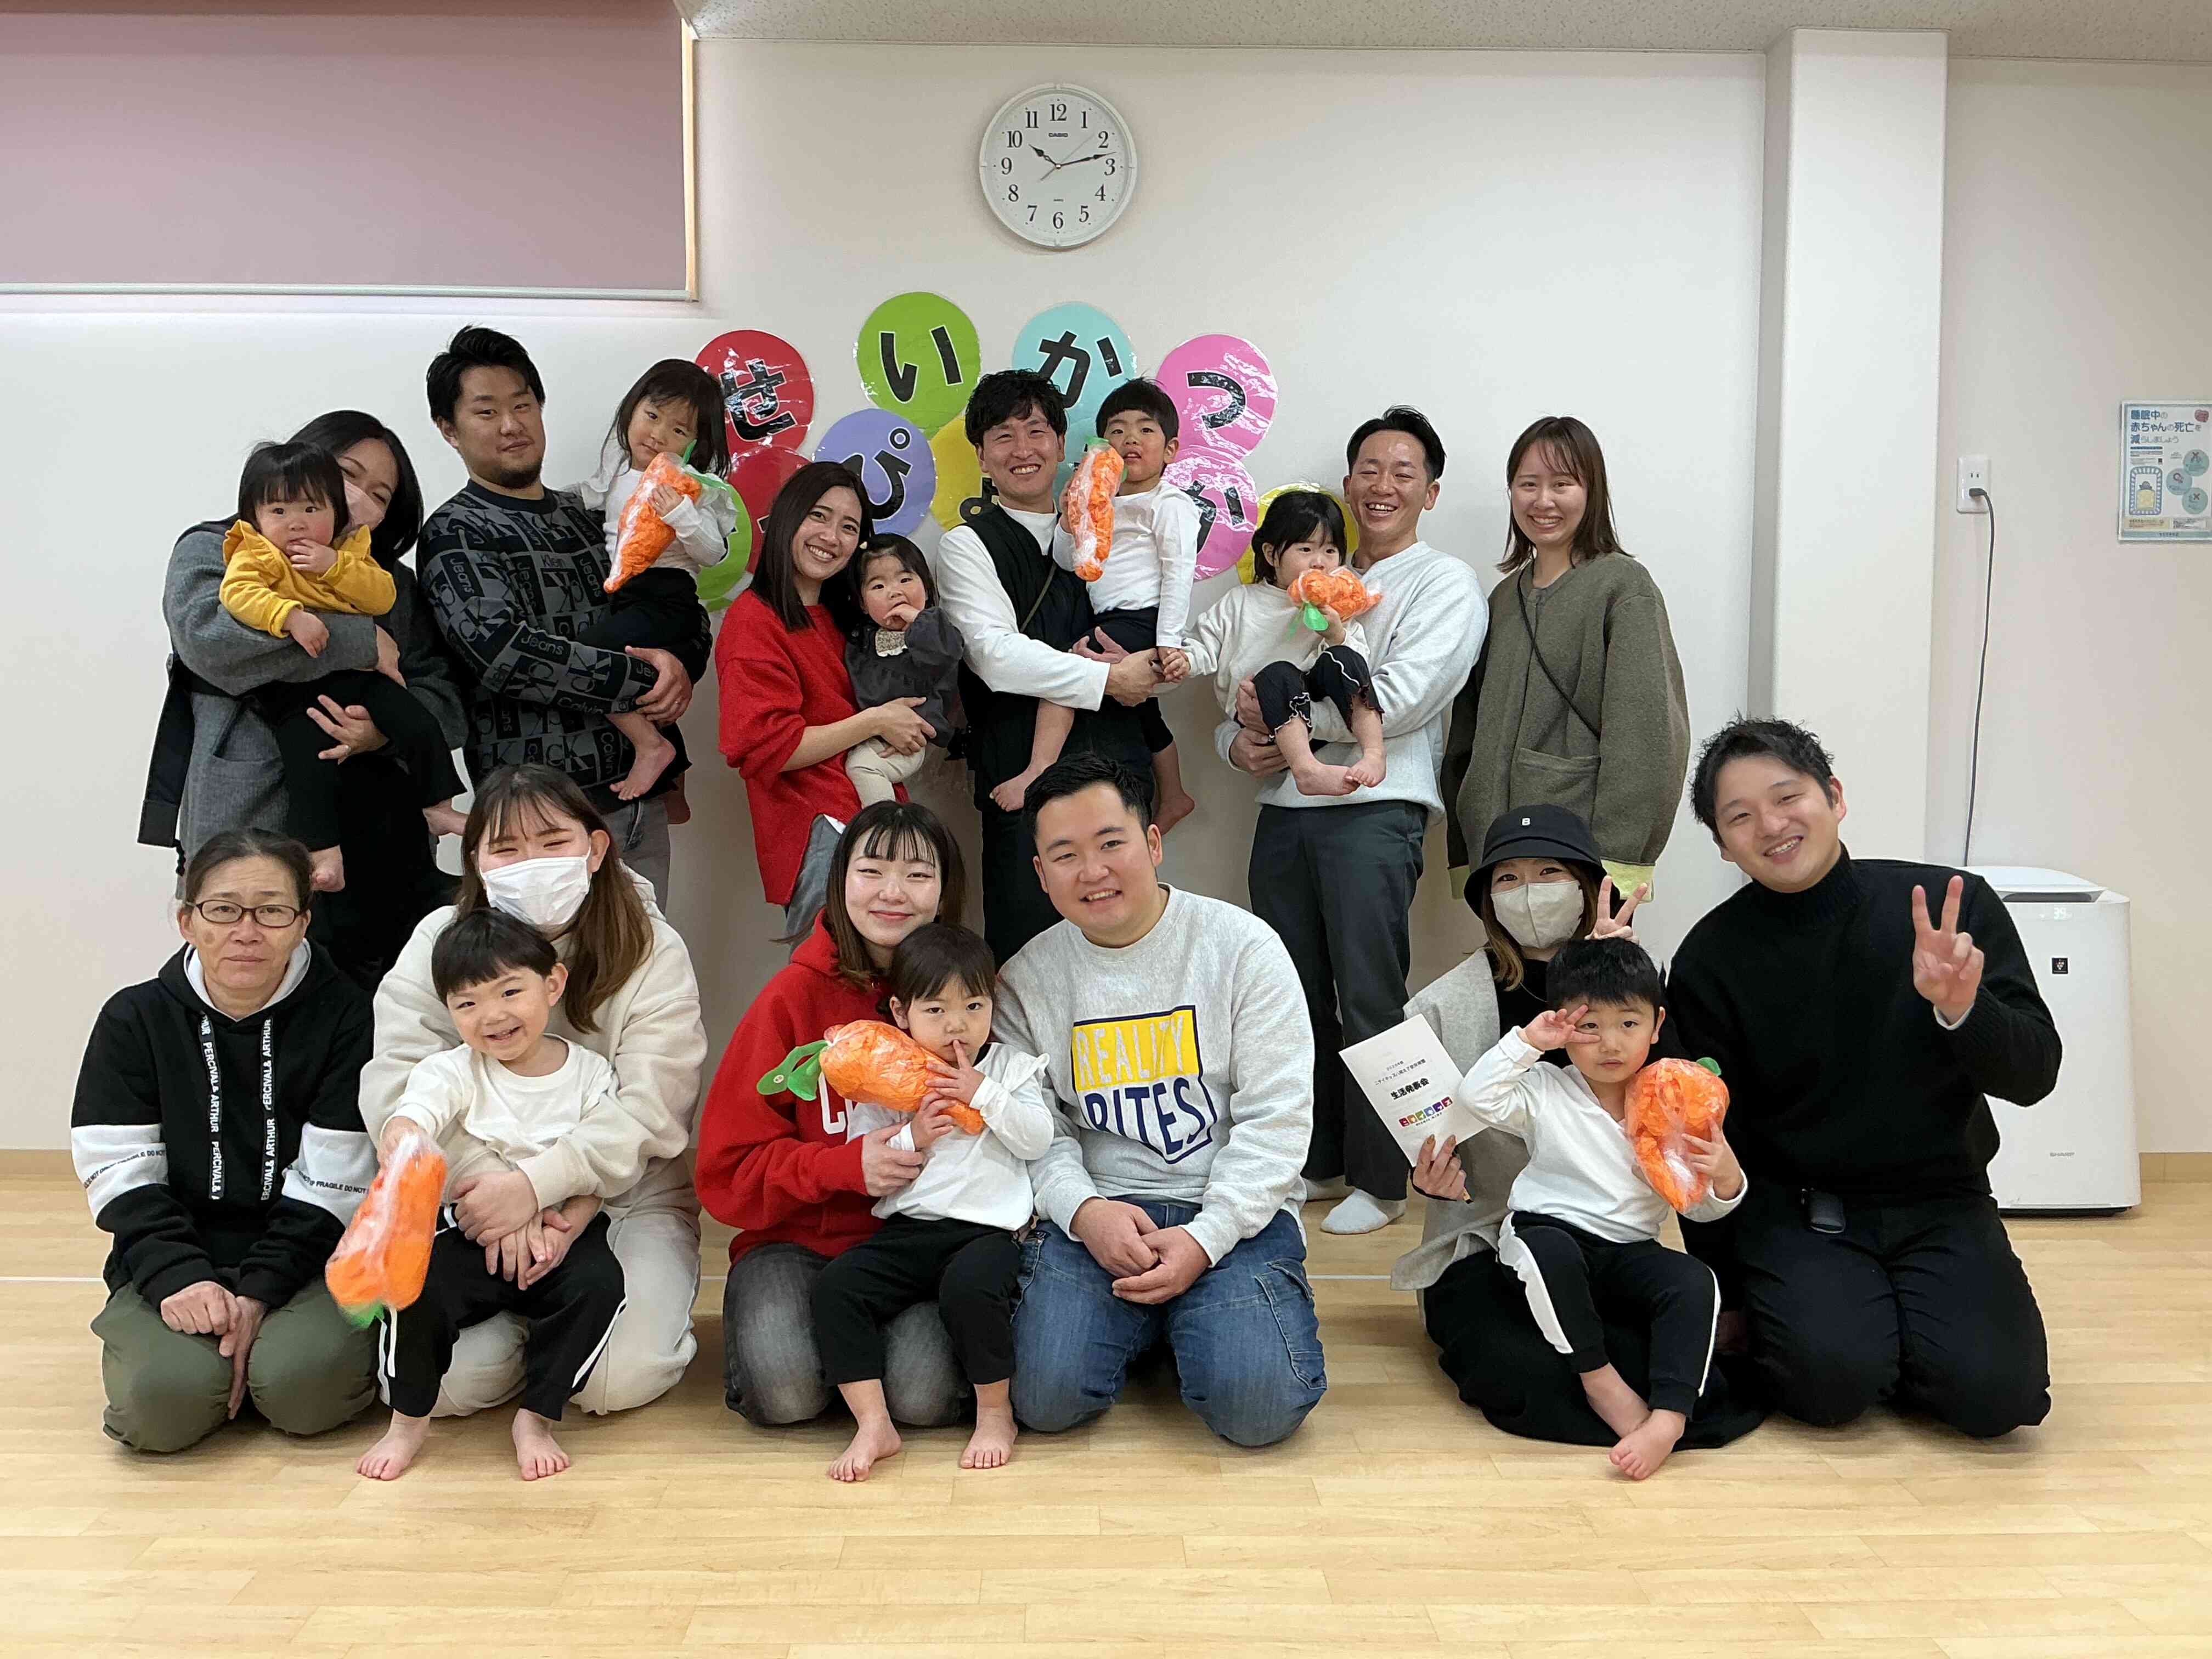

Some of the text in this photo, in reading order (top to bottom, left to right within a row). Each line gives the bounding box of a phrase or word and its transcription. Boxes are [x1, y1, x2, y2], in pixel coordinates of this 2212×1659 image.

[1025, 111, 1039, 128] 11
[1049, 104, 1067, 121] 12
[1081, 110, 1088, 128] 1
[1007, 131, 1023, 148] 10
[1098, 131, 1109, 148] 2
[1001, 157, 1012, 174] 9
[1104, 159, 1115, 176] 3
[1008, 184, 1019, 202] 8
[1095, 184, 1106, 201] 4
[1027, 205, 1037, 222] 7
[1053, 212, 1063, 229] 6
[1079, 205, 1089, 222] 5
[719, 325, 1246, 442] せ い か つ
[1522, 817, 1531, 826] B
[262, 1019, 272, 1057] ARTHUR
[1075, 1015, 1184, 1088] REALITY
[1390, 1077, 1430, 1101] 生活発表会
[210, 1094, 220, 1133] ARTHUR
[265, 1118, 275, 1158] ARTHUR
[316, 1181, 343, 1190] FRAGILE
[353, 1186, 366, 1194] NOT
